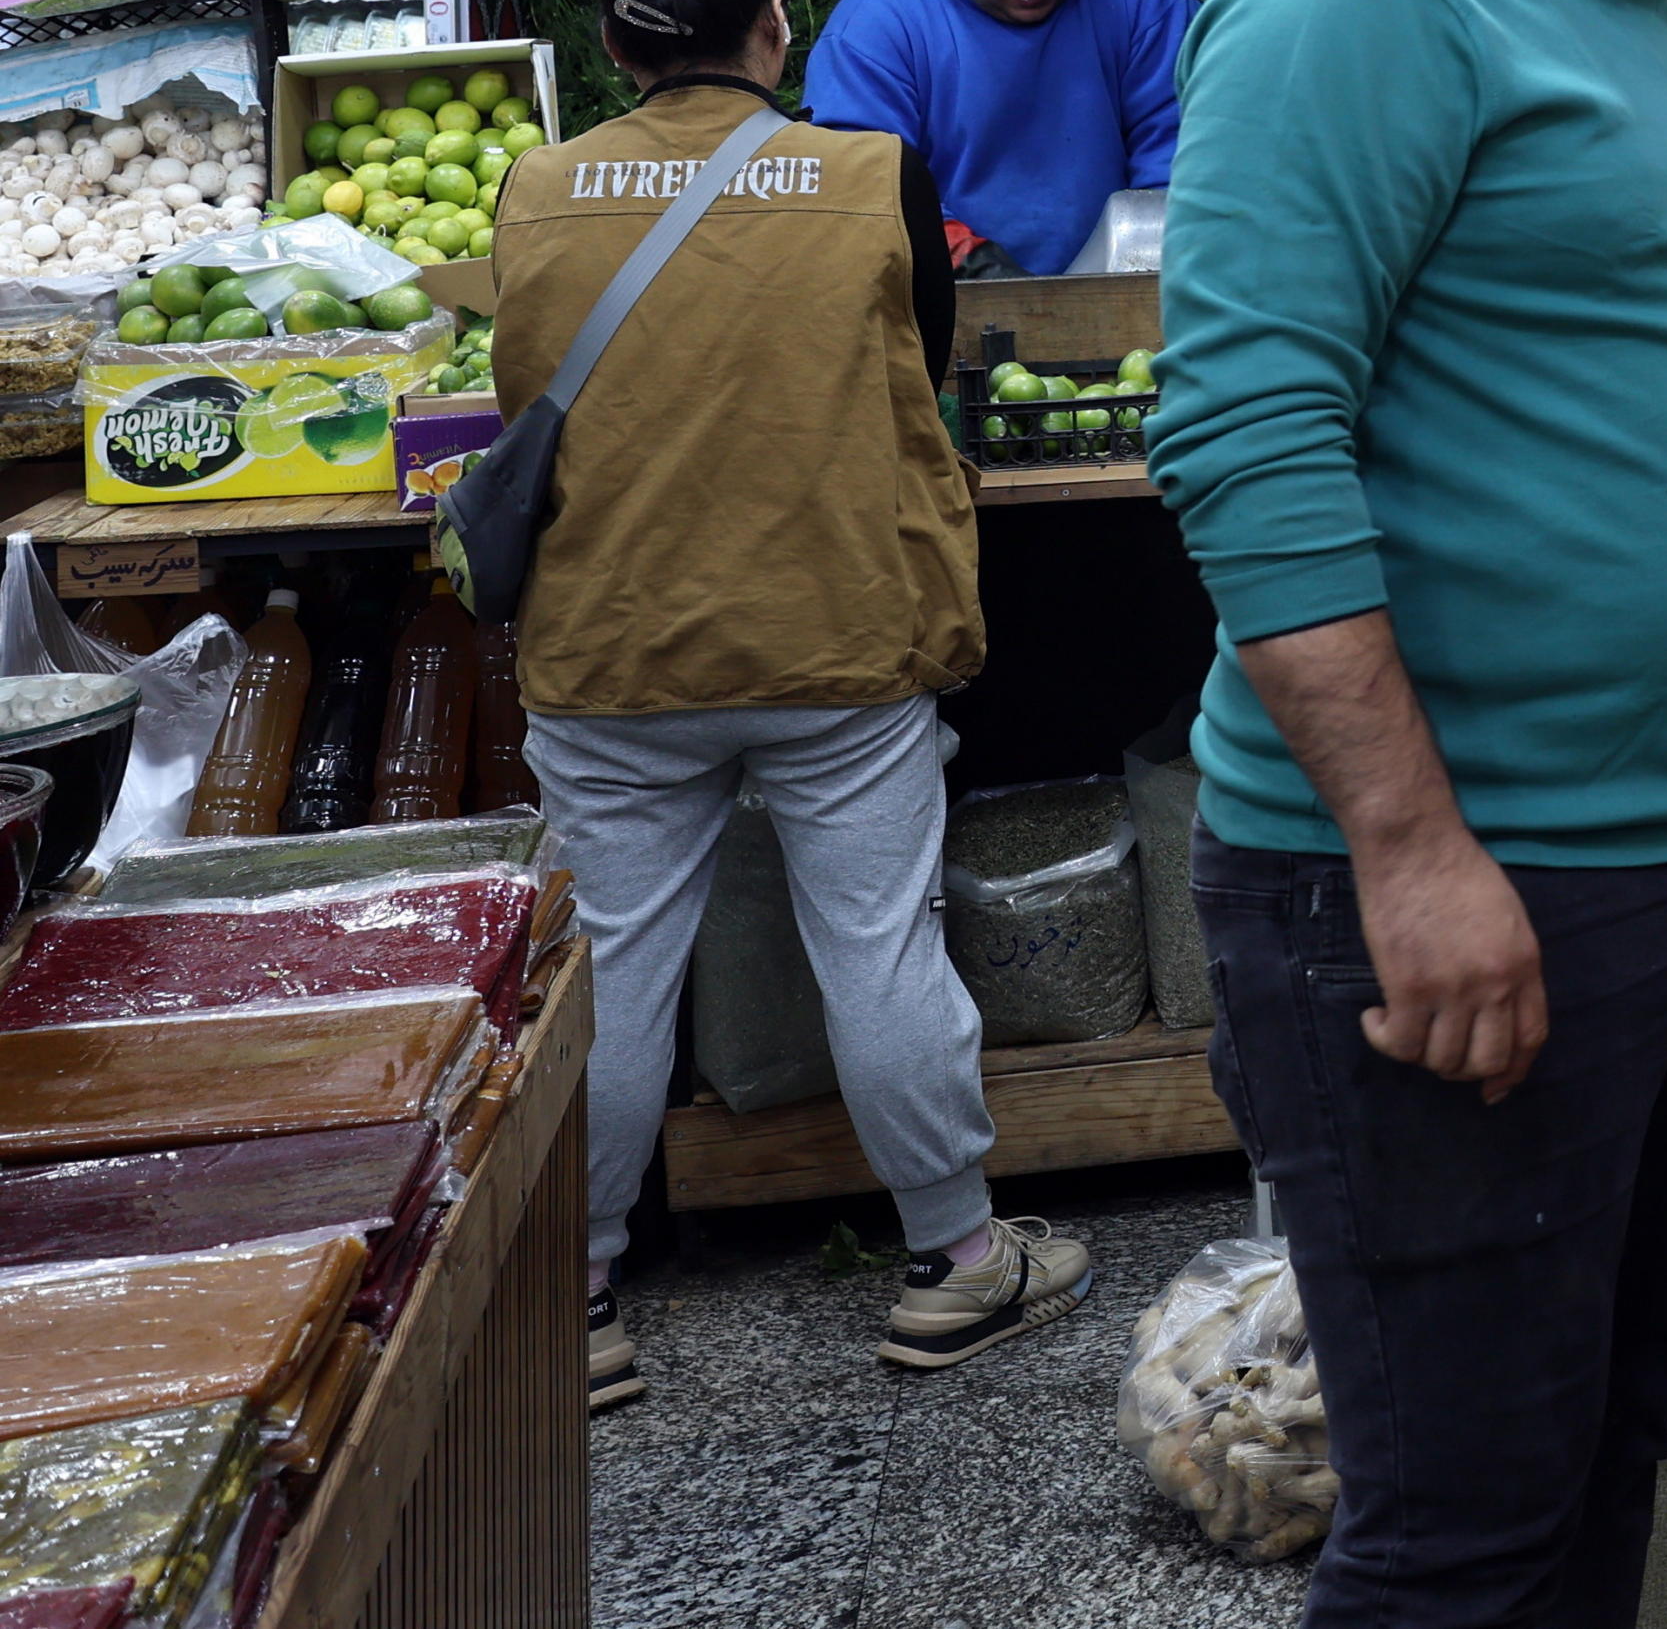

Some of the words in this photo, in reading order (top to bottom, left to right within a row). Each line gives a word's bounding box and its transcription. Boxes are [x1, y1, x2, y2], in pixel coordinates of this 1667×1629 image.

[105, 398, 208, 440] Lemon
[134, 419, 231, 464] Fresh
[419, 442, 463, 462] Vitamin
[71, 560, 137, 590] سیب
[138, 542, 196, 588] سرکه
